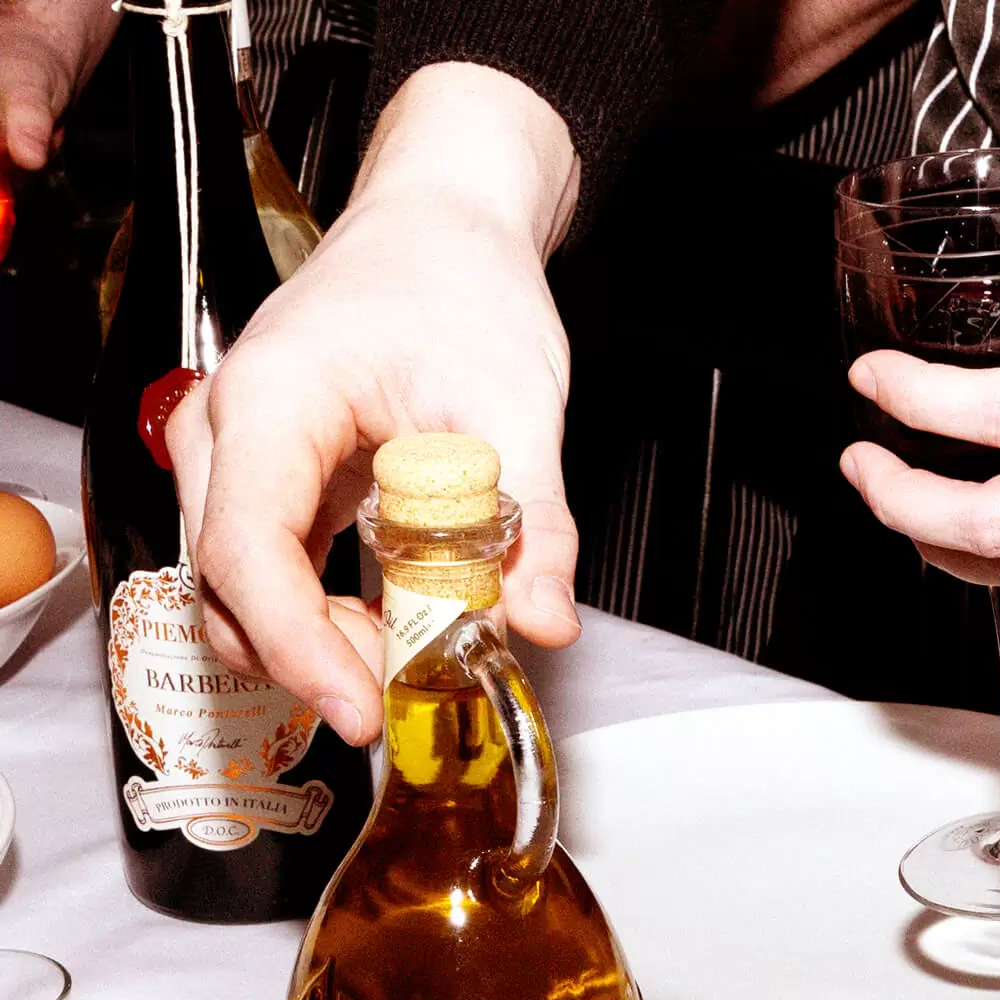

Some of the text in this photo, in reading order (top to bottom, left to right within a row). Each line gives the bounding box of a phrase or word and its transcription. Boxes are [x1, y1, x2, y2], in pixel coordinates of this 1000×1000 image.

[155, 703, 194, 718] Marco
[155, 796, 288, 815] PRODOTTO IN ITALIA
[203, 825, 240, 837] D.O.C.
